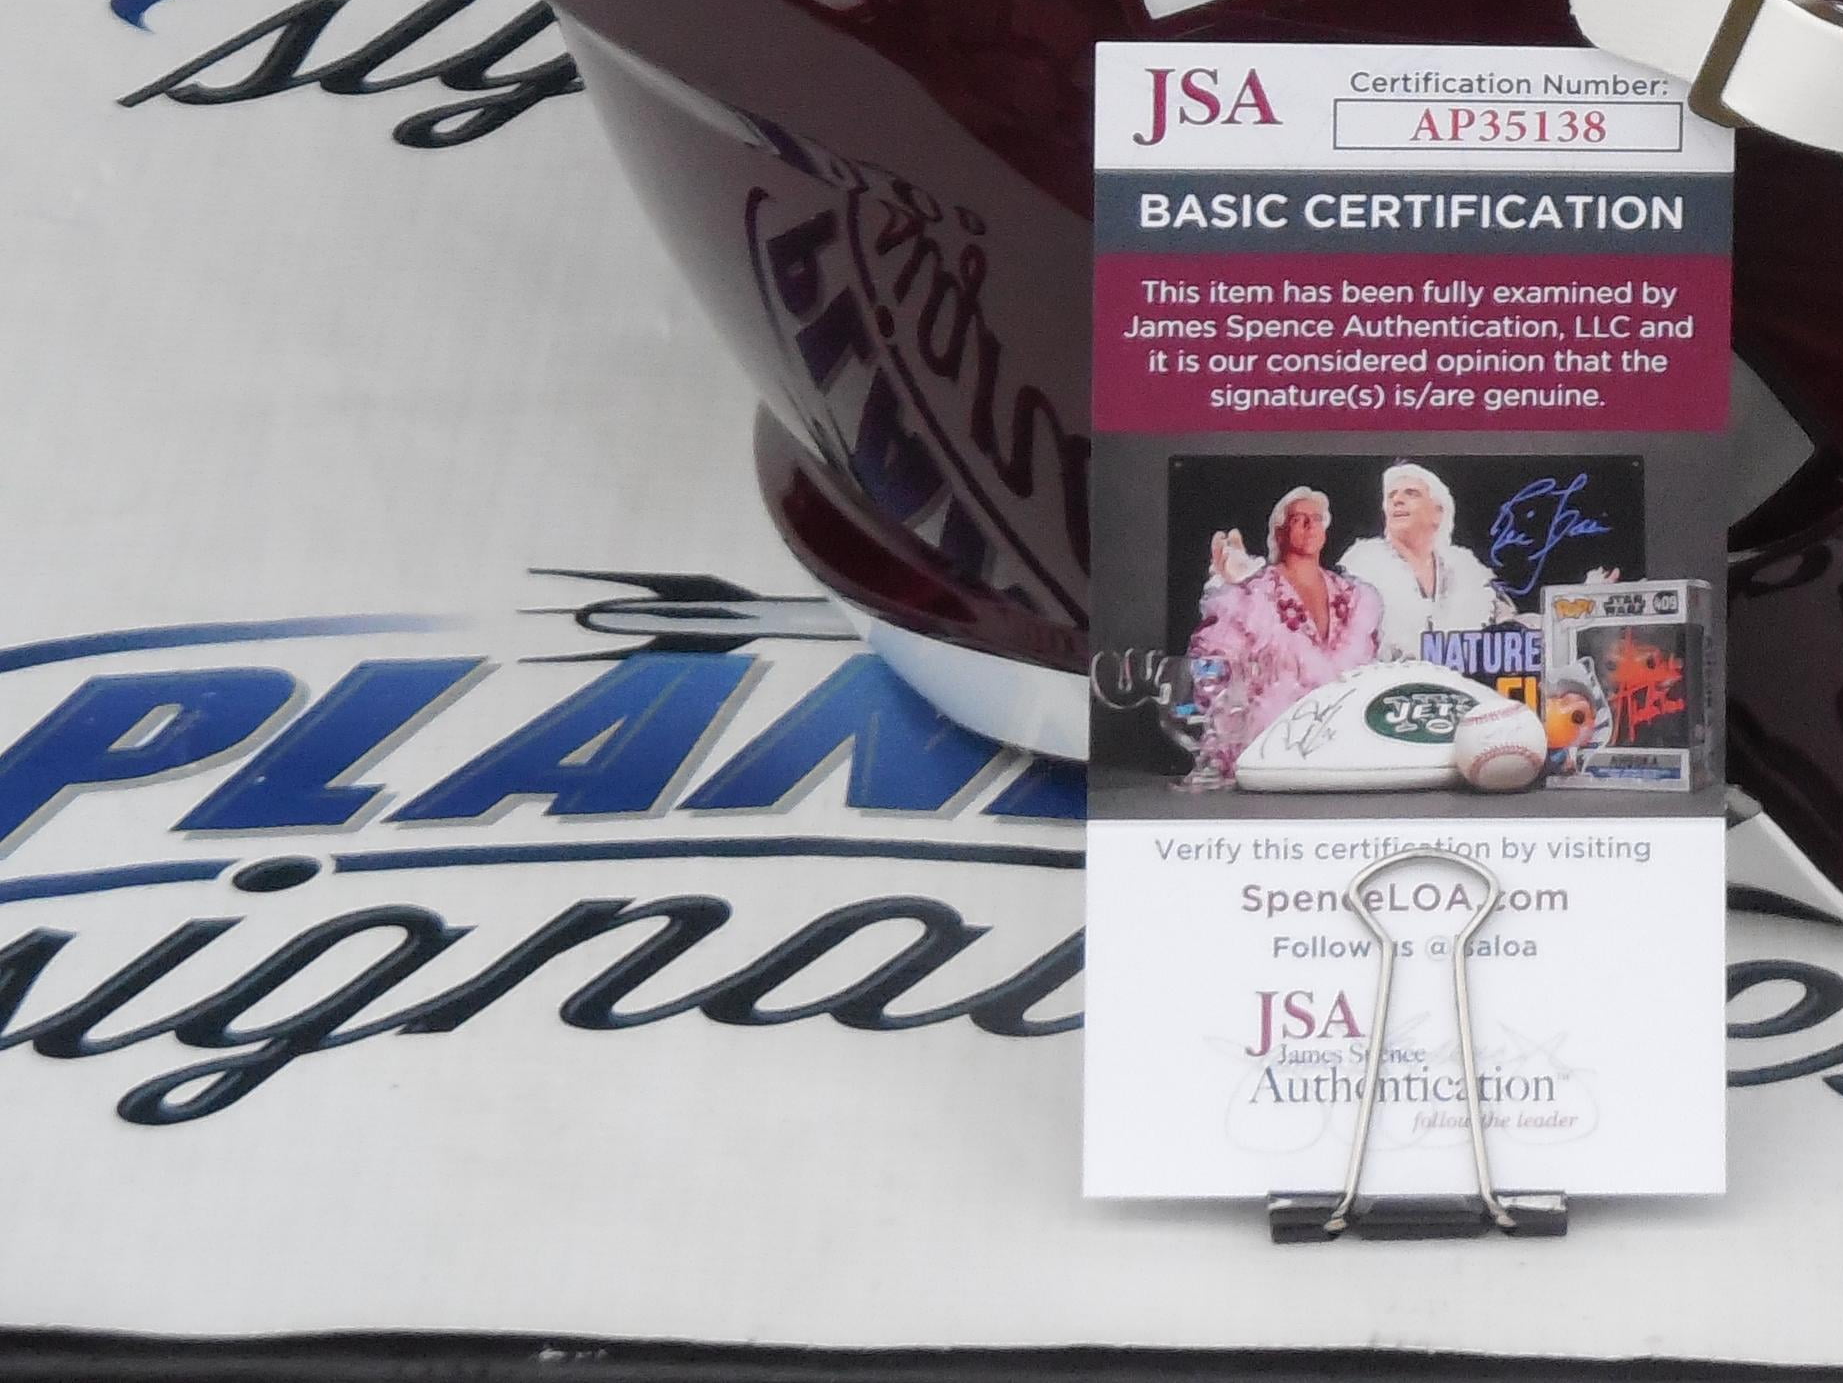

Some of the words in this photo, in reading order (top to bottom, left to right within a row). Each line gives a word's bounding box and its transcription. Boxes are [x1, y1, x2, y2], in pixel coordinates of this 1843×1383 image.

[1350, 71, 1532, 94] Certification
[1544, 74, 1668, 96] Number:
[1132, 67, 1284, 147] JSA
[1410, 108, 1608, 143] AP35138
[1140, 193, 1289, 228] BASIC
[1303, 193, 1685, 230] CERTIFICATION
[1141, 280, 1200, 304] This
[1210, 281, 1273, 304] item
[1284, 280, 1332, 304] has
[1343, 280, 1414, 304] been
[1423, 280, 1484, 307] fully
[1493, 281, 1633, 304] examined
[1642, 281, 1677, 308] by
[1123, 315, 1217, 339] James
[1226, 315, 1334, 341] Spence
[1343, 315, 1565, 340] Authentication,
[1575, 316, 1631, 338] LLC
[1639, 316, 1694, 338] and
[1149, 349, 1168, 373] it
[1178, 349, 1200, 373] is
[1208, 354, 1258, 373] our
[1266, 349, 1427, 373] considered
[1436, 349, 1546, 375] opinion
[1554, 349, 1612, 373] that
[1620, 349, 1668, 372] the
[1210, 382, 1386, 410] signature(s)
[1395, 382, 1475, 409] is/are
[1483, 384, 1607, 410] genuine.
[1422, 630, 1543, 674] NATURE
[1155, 837, 1242, 864] Verify
[1252, 837, 1304, 861] this
[1501, 837, 1537, 864] by
[1546, 838, 1652, 863] visiting
[1272, 935, 1372, 958] Follow
[1245, 989, 1366, 1058] JSA
[1277, 1043, 1343, 1064] James
[1516, 1111, 1579, 1129] leader
